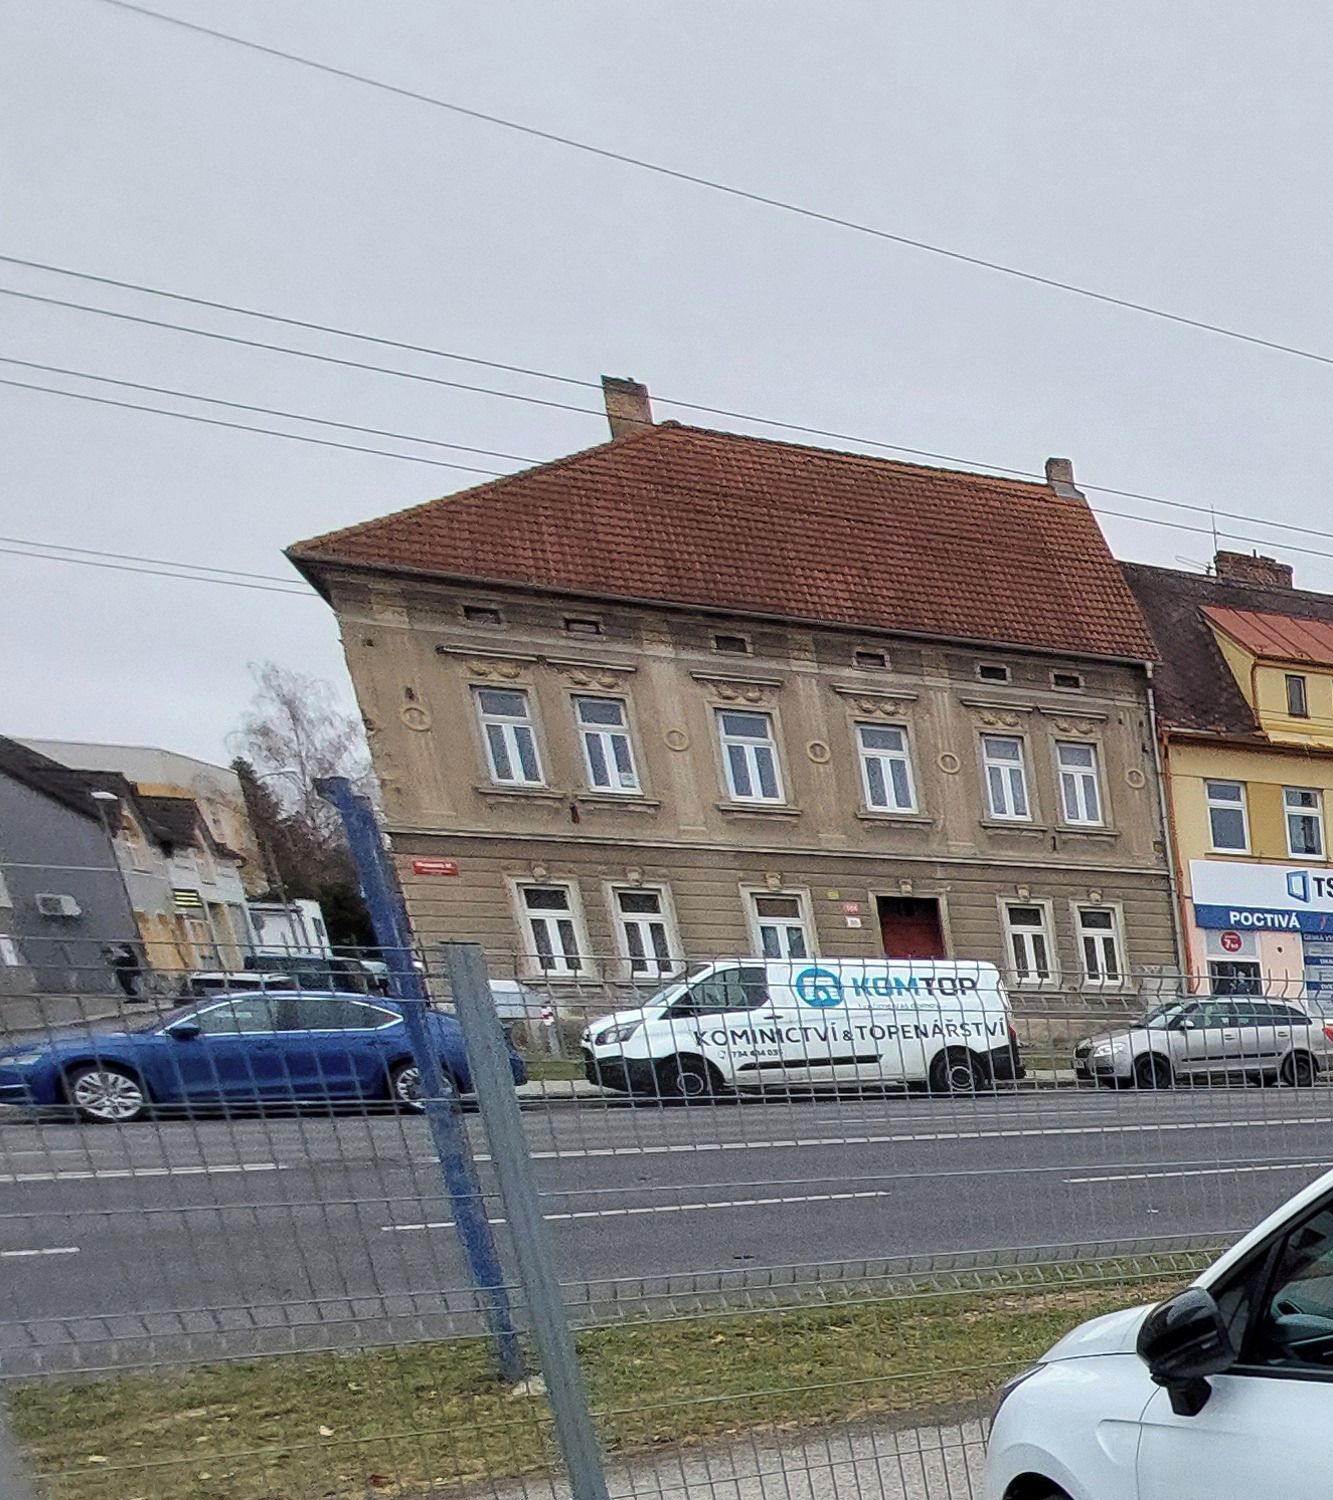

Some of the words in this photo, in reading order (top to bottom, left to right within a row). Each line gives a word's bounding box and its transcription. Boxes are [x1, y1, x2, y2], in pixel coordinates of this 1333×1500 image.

[1229, 911, 1300, 929] POCTIVÁ
[850, 976, 977, 997] KOMTOP
[694, 1021, 839, 1047] KOMINICTVÍ
[842, 1030, 854, 1041] &
[855, 1017, 1006, 1041] TOPENÁŘSTVÍ
